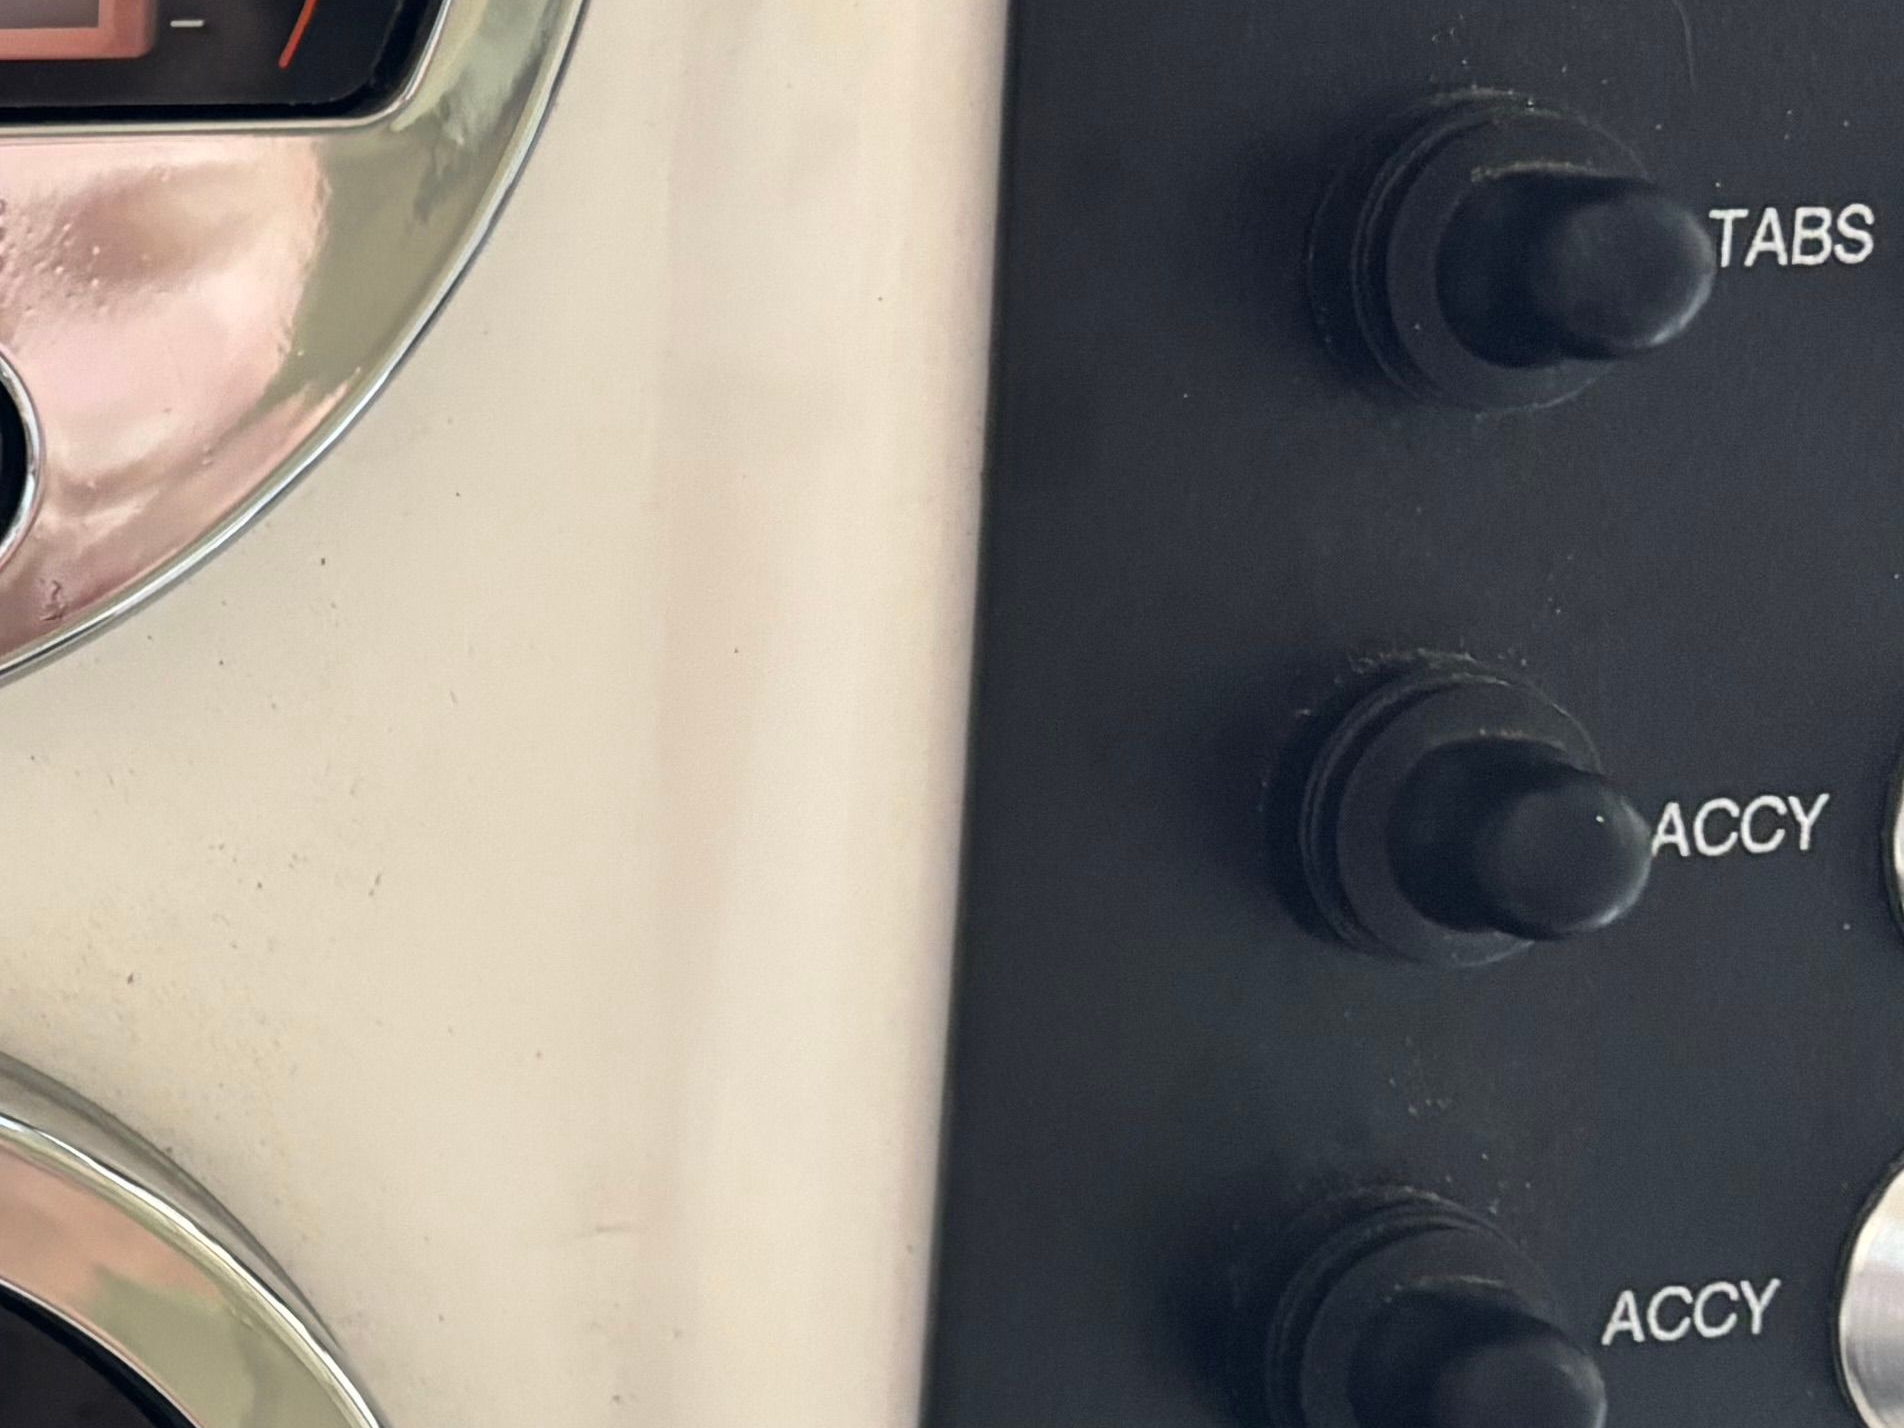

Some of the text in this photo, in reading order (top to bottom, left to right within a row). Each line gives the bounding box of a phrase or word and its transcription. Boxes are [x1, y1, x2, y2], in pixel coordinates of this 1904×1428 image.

[1708, 203, 1876, 268] TABS
[1650, 793, 1831, 858] ACCY
[1601, 1278, 1782, 1347] ACCY
